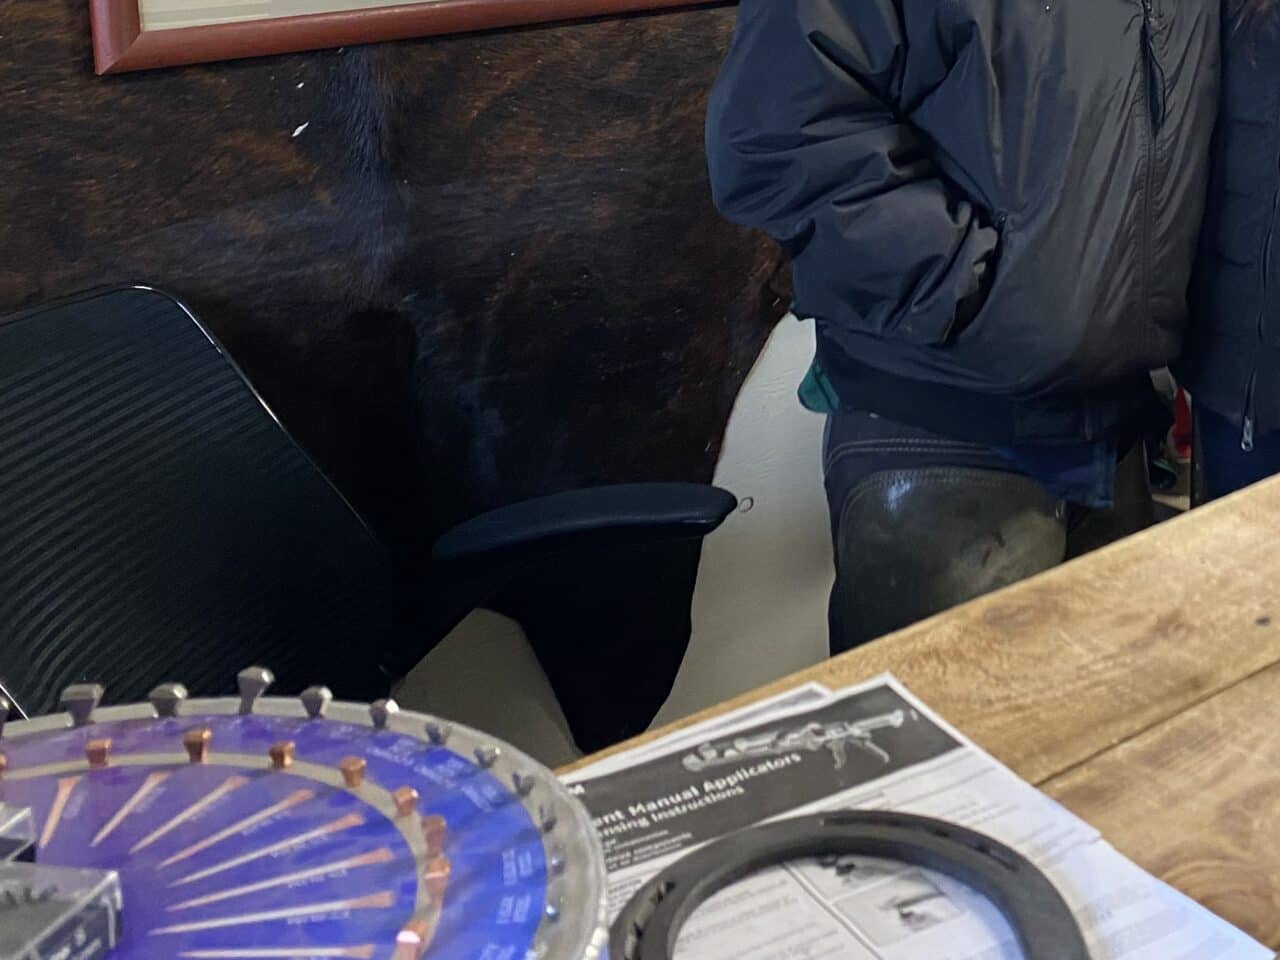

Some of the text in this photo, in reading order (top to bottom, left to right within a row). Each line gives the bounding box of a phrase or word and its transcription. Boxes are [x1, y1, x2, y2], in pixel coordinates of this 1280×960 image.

[628, 785, 700, 815] Manual
[703, 752, 802, 793] Applicators
[650, 784, 745, 823] Instructions
